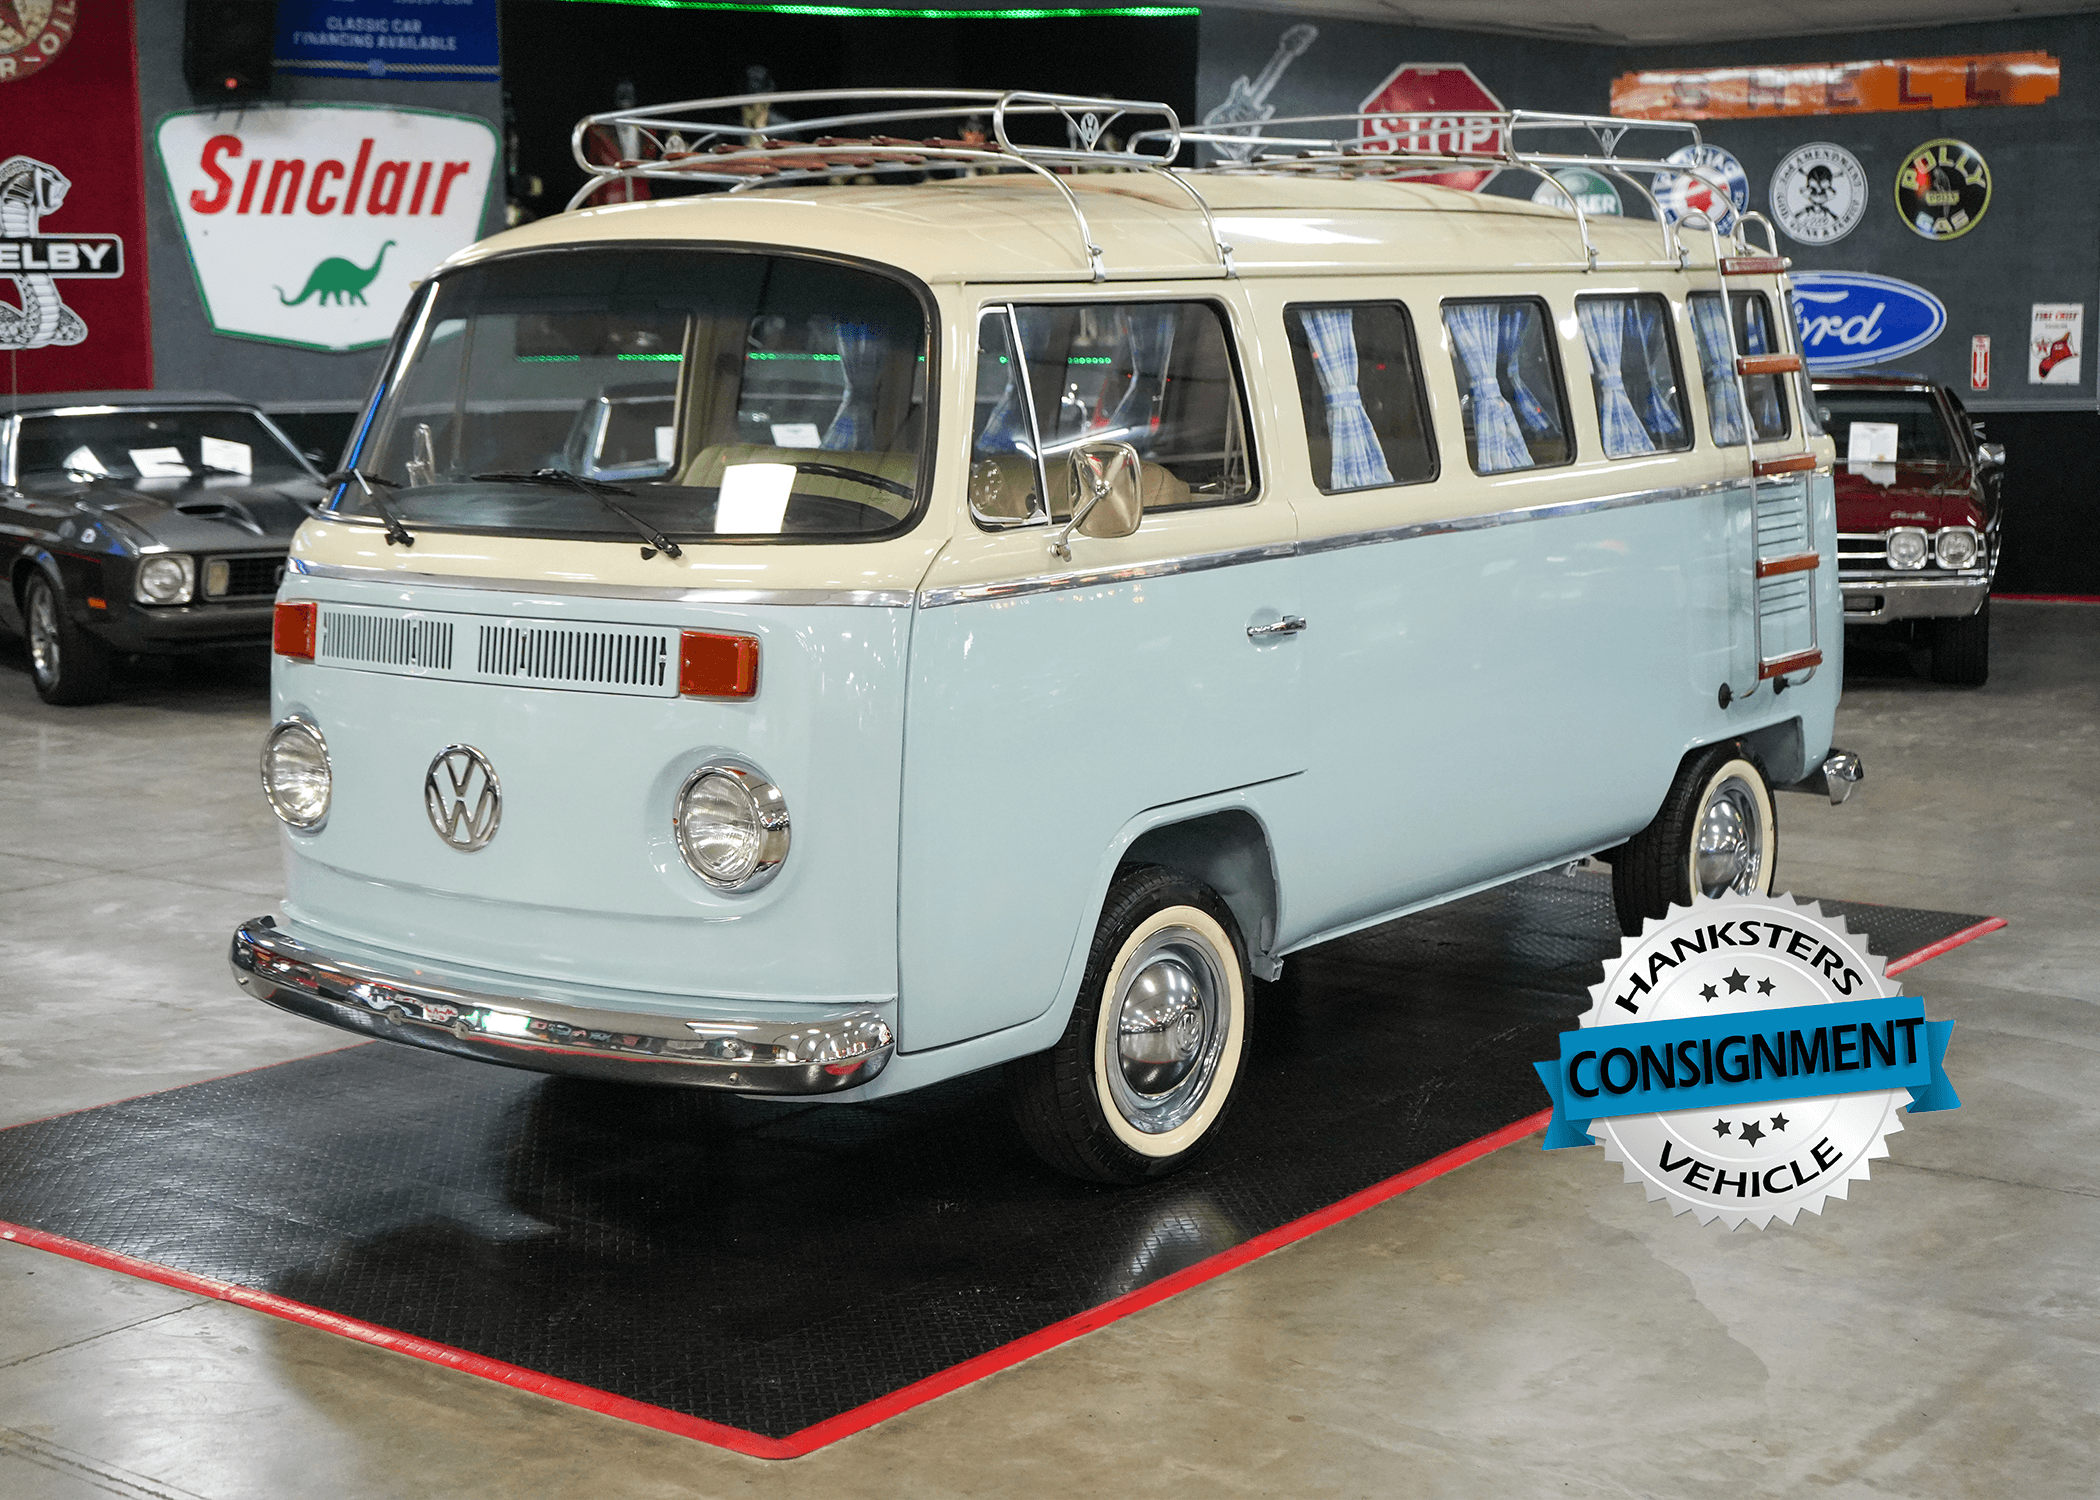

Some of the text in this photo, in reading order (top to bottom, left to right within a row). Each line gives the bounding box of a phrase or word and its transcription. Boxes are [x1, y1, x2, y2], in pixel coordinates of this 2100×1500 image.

[293, 30, 457, 51] FINANCING AVAILABLE
[325, 15, 422, 34] CLASSIC CAR
[1369, 110, 1492, 153] STOP
[190, 134, 469, 216] Sinclair
[1901, 145, 1987, 191] POLLY
